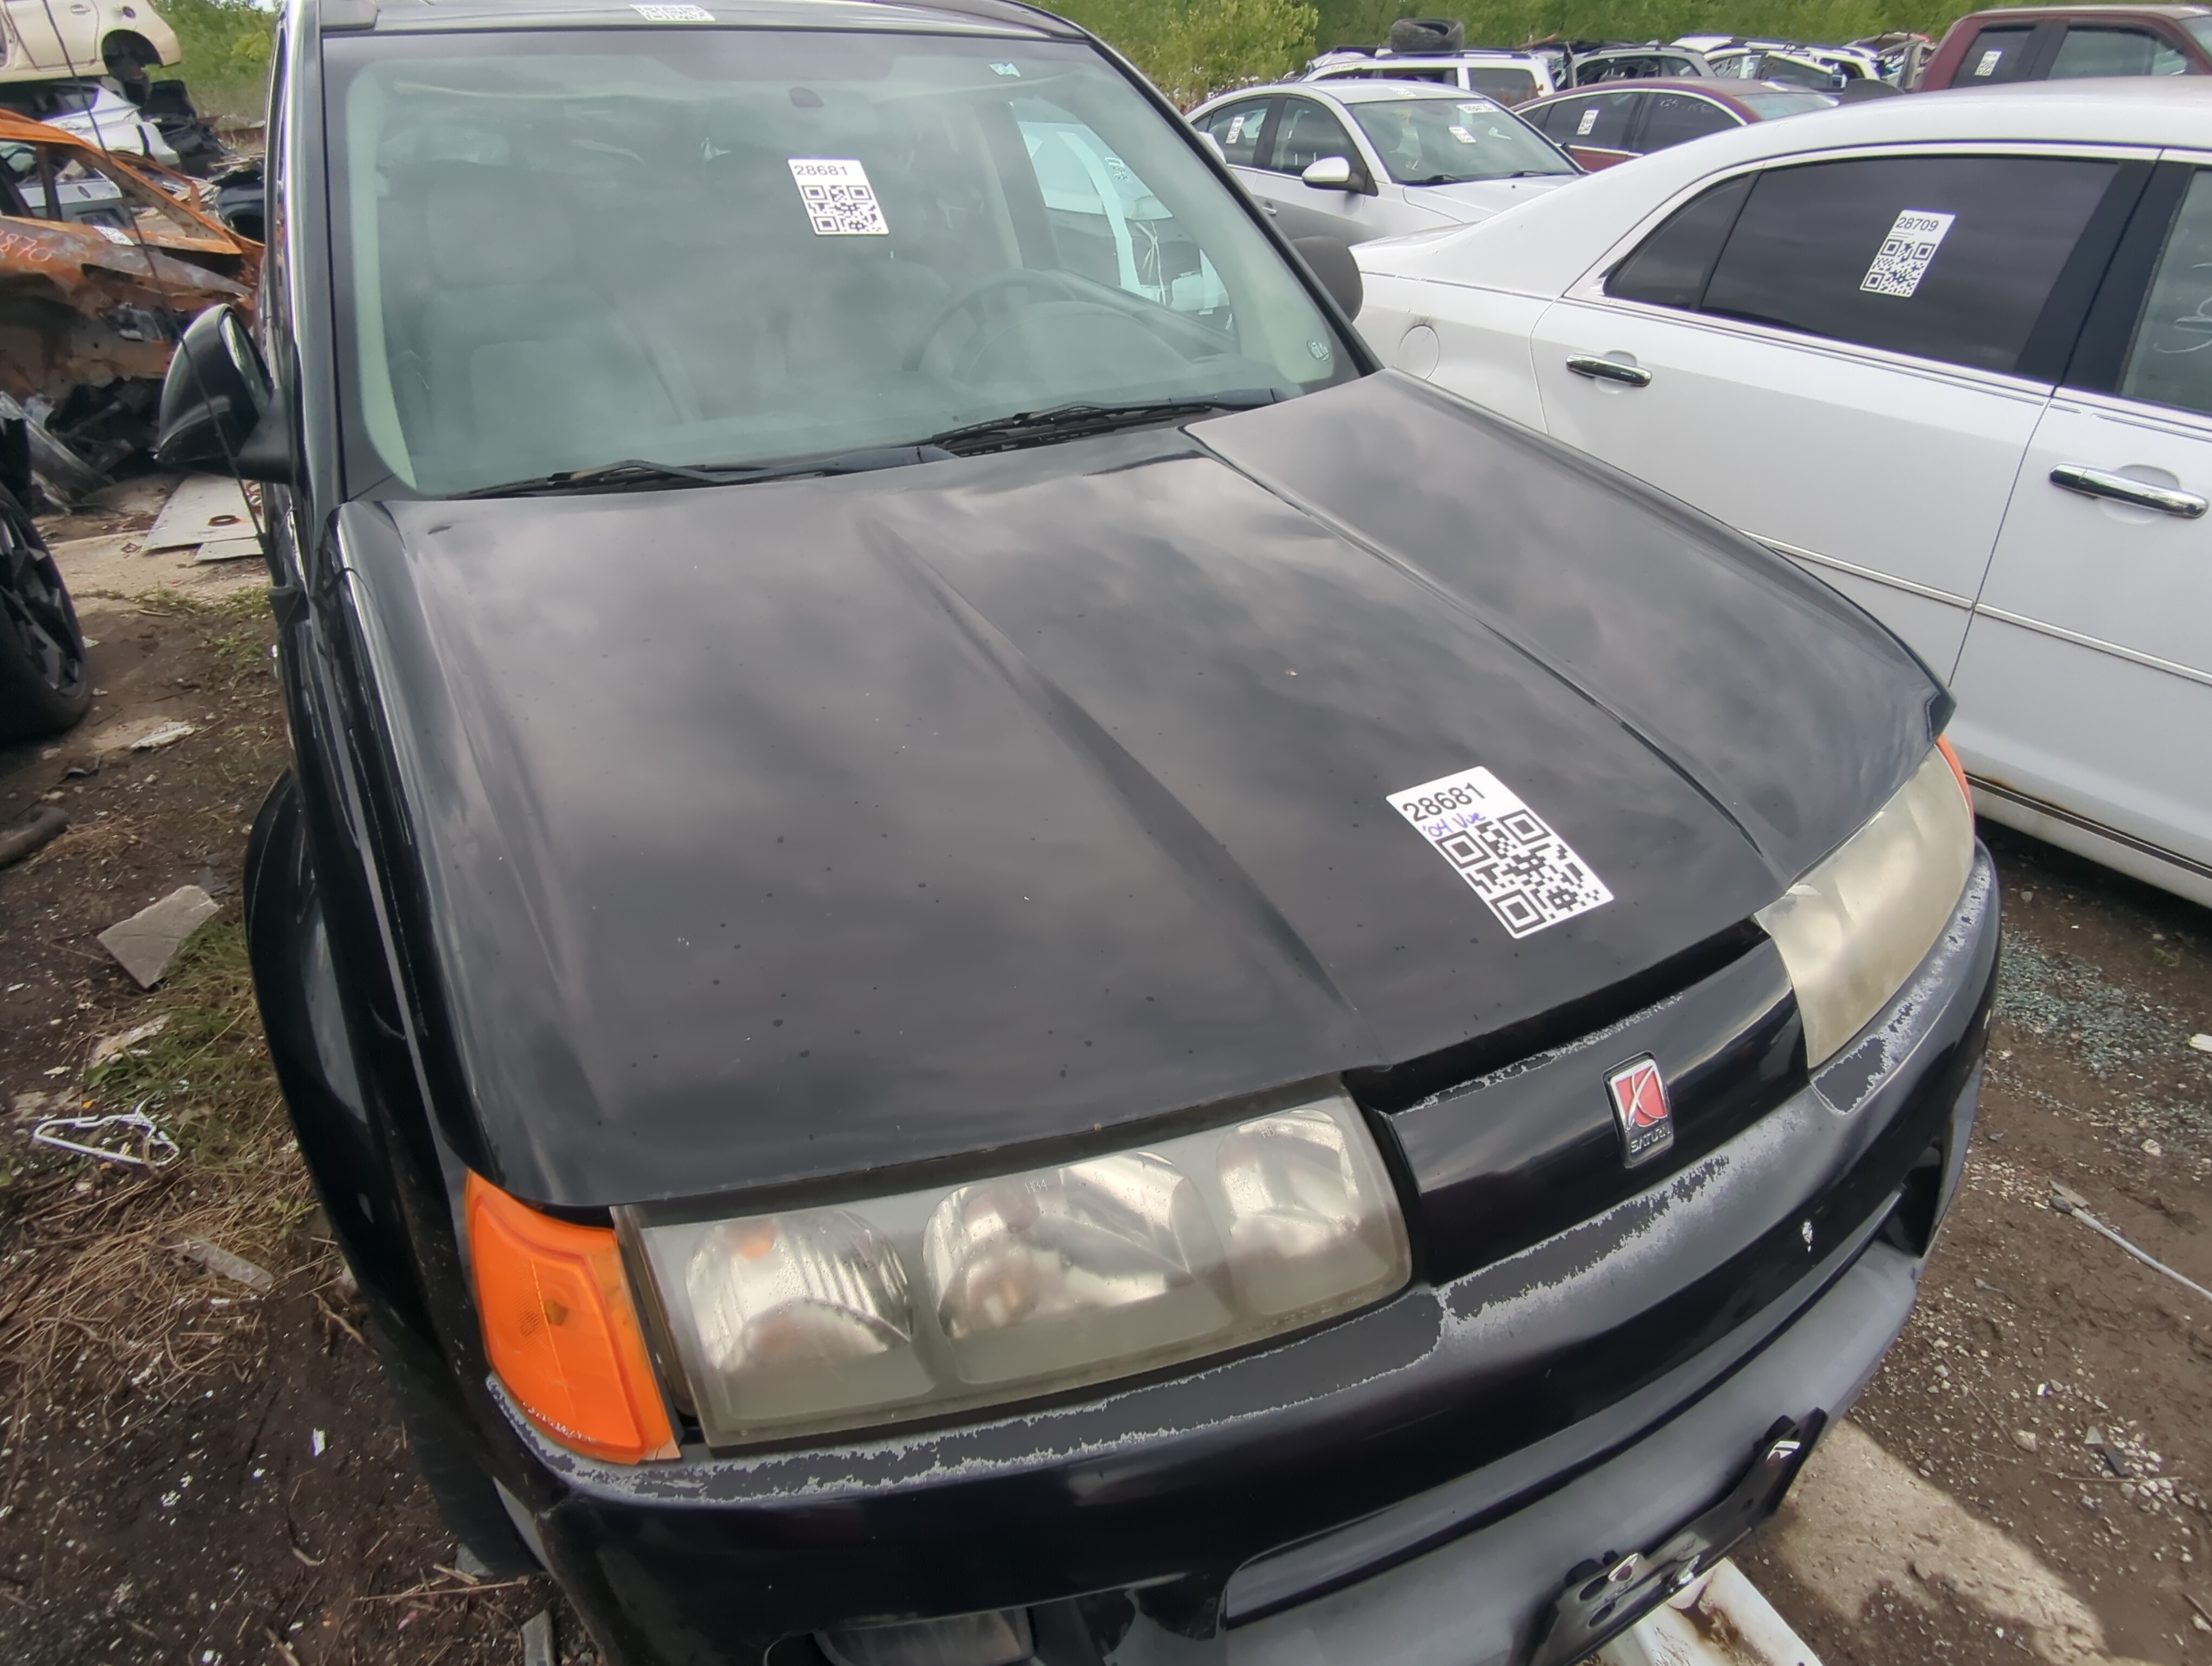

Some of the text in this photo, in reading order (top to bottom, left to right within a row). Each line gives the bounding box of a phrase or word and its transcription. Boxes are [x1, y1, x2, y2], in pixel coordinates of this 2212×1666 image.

[794, 165, 848, 176] 28681
[1895, 216, 1939, 232] 28709
[1402, 782, 1486, 822] 28681
[1451, 812, 1487, 829] Vue
[1630, 1123, 1671, 1153] SATURN
